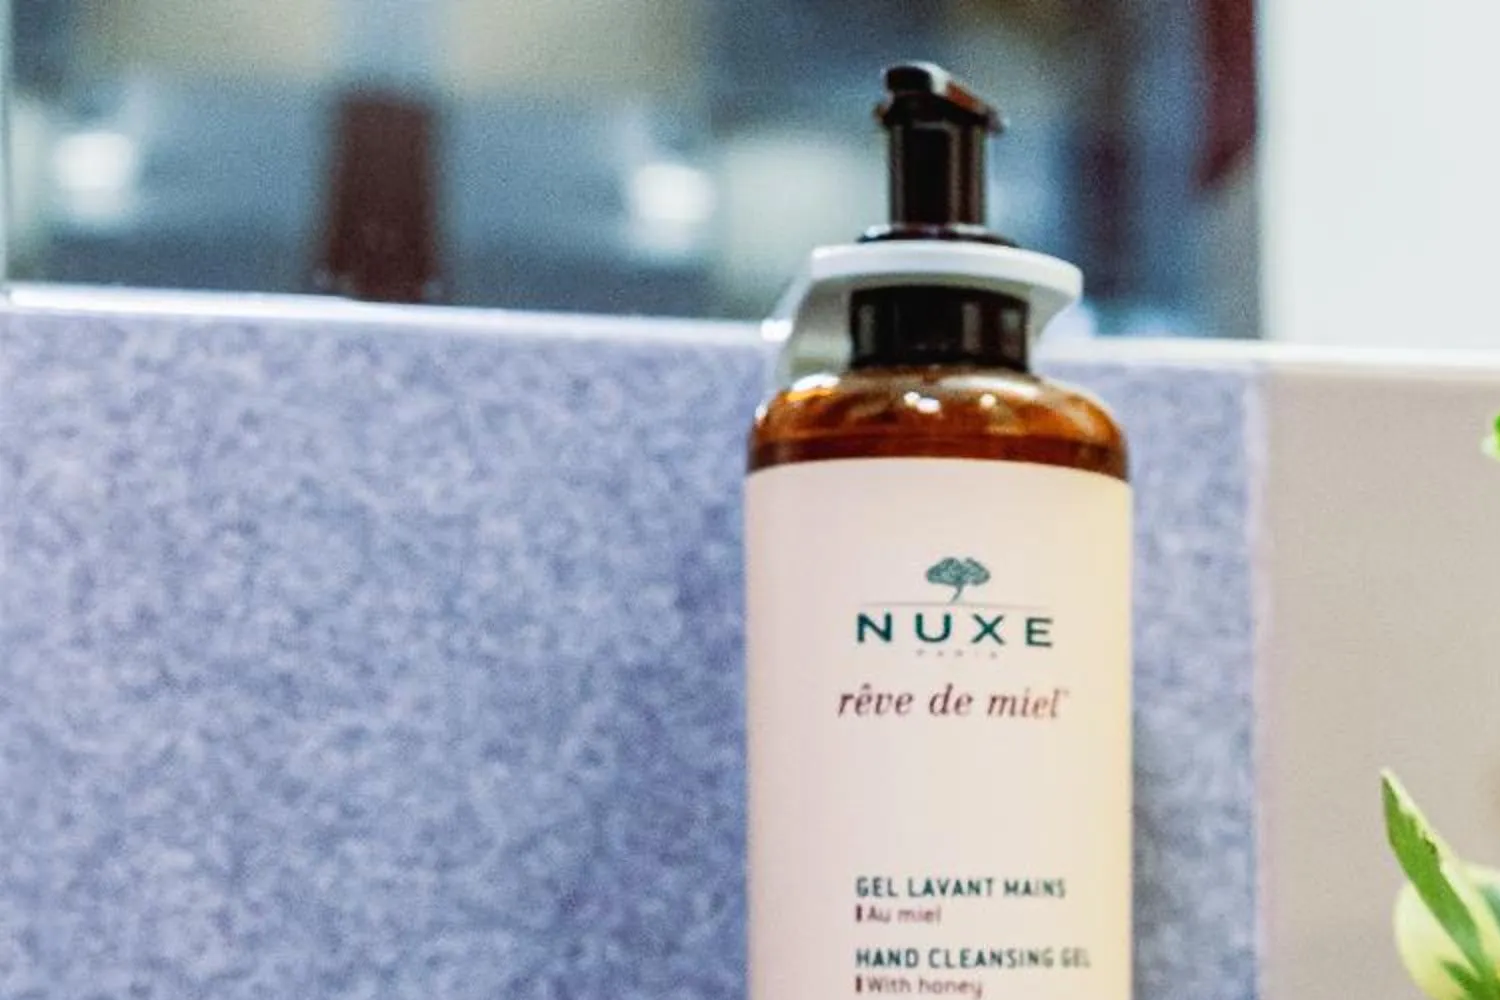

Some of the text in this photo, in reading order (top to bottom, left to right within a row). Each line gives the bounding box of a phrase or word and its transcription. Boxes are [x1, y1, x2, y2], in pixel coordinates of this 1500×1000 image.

[856, 612, 1053, 648] NUXE
[838, 683, 912, 717] rêve
[928, 683, 973, 716] de
[856, 877, 1066, 898] GEL LAVANT MAINS
[867, 907, 942, 923] Au miel
[856, 948, 1090, 968] HAND CLEANSING GEL
[868, 976, 983, 1000] With honey
